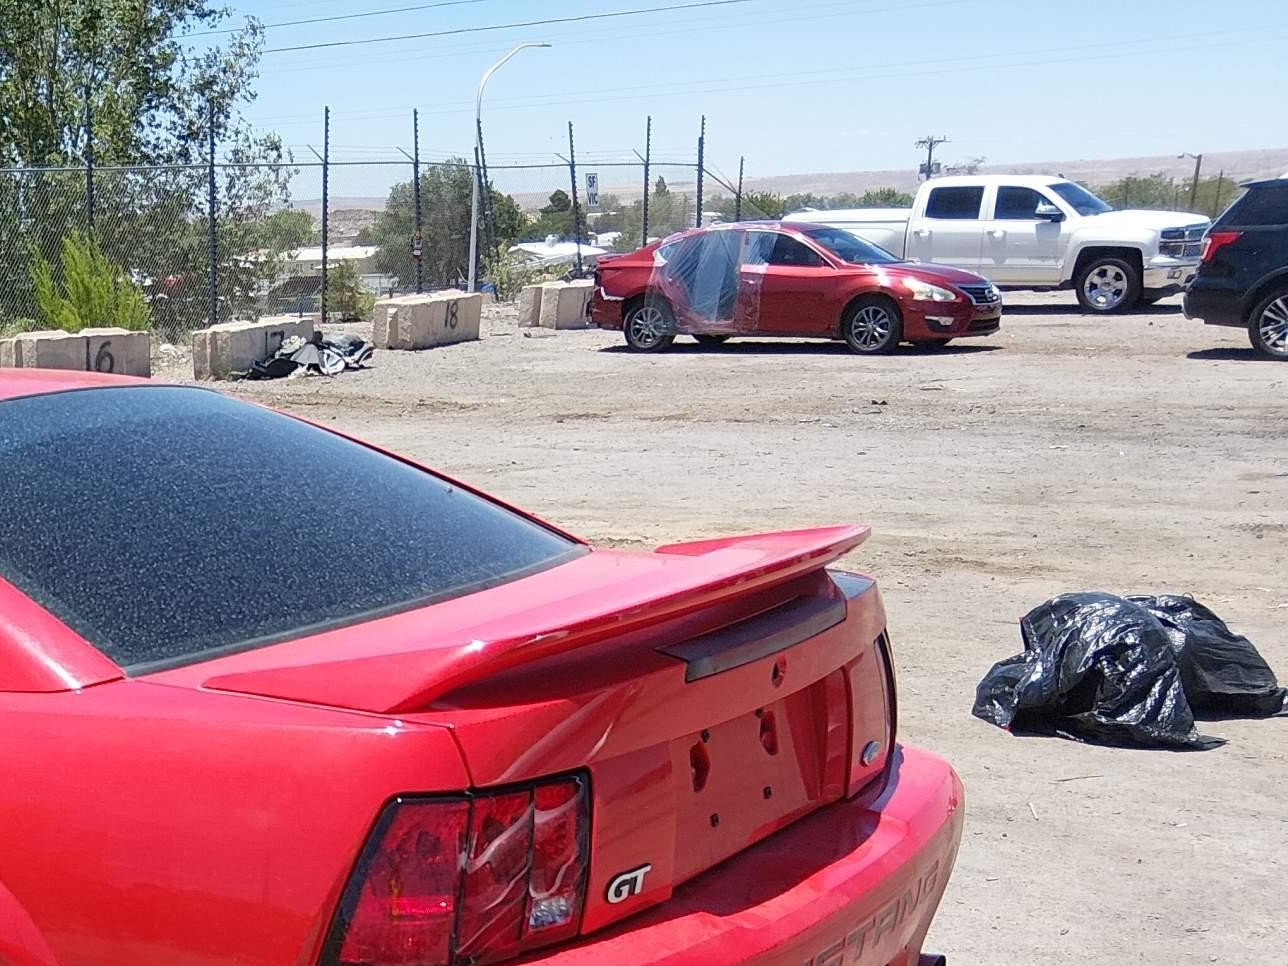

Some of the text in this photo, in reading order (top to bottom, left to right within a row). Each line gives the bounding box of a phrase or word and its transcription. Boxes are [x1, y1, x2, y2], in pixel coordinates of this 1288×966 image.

[444, 301, 458, 330] 18
[86, 337, 114, 373] 16
[606, 864, 652, 904] GT
